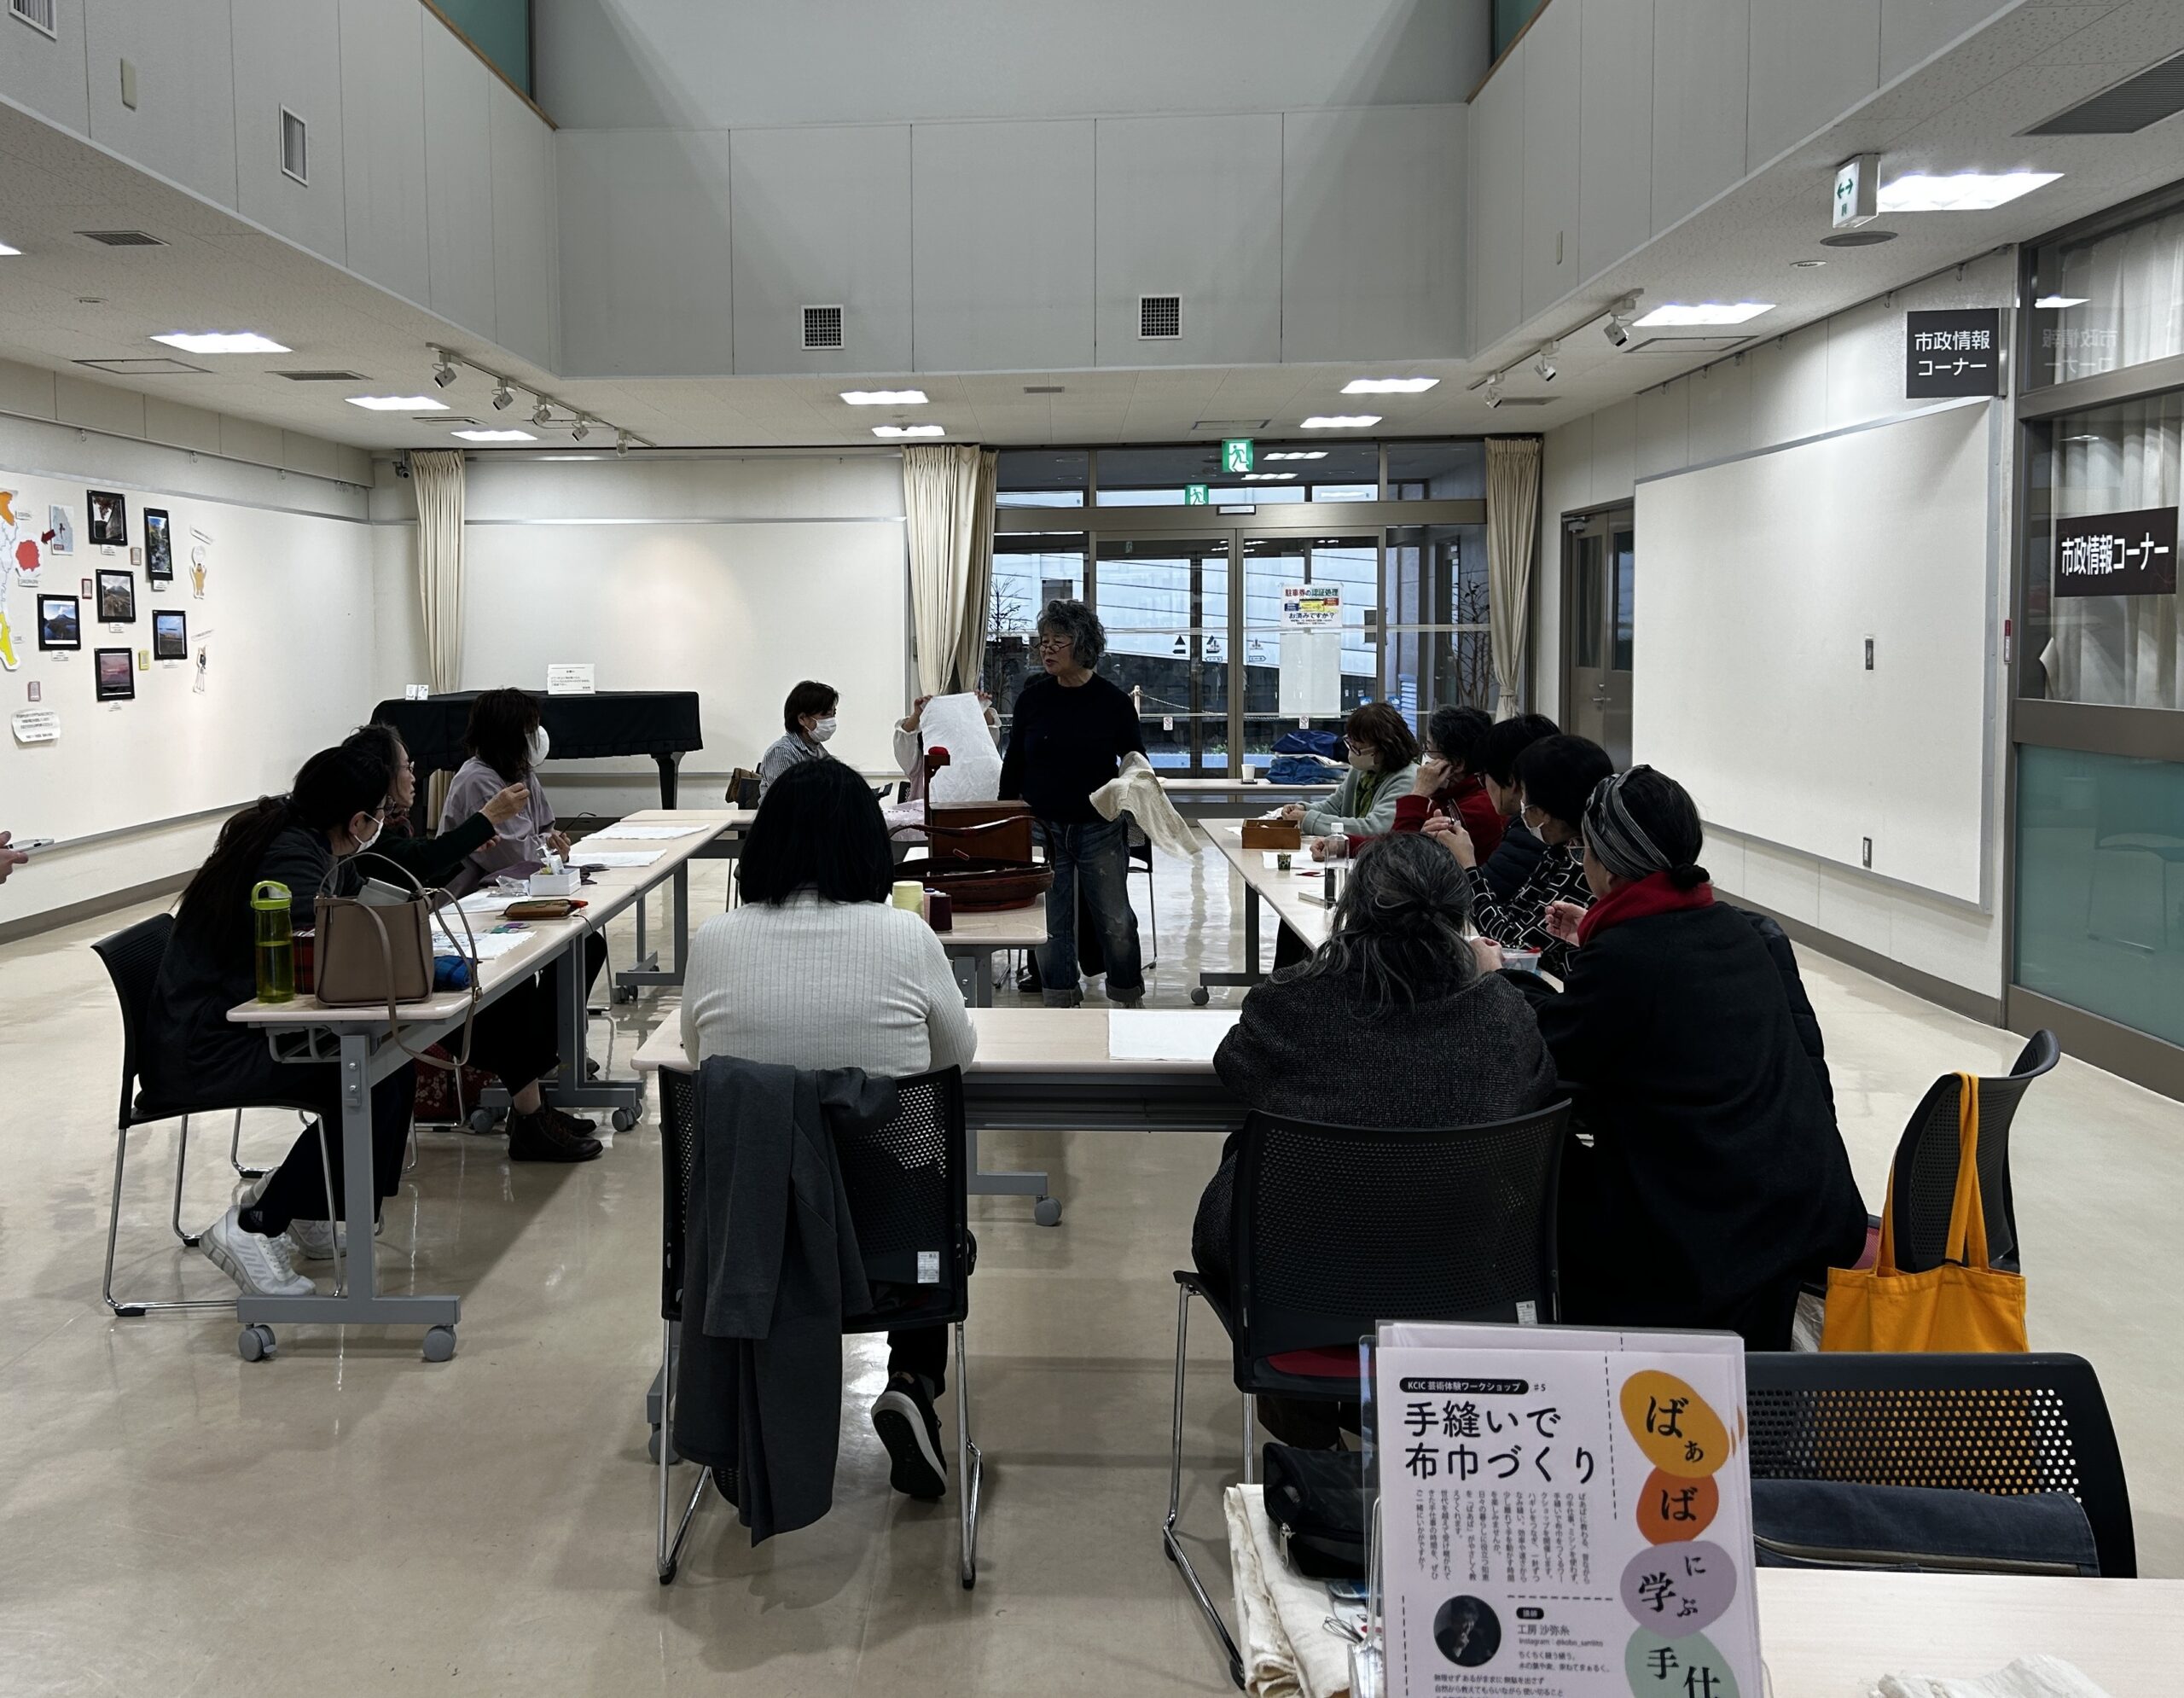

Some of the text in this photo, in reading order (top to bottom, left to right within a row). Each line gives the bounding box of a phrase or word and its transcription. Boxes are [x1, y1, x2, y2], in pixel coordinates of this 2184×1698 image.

[1914, 330, 1990, 352] 市政情報
[1918, 358, 1987, 376] コーナー
[2060, 532, 2170, 576] 市政情報コーナー
[1408, 1381, 1426, 1390] KCIC
[1427, 1381, 1521, 1393] 芸術体験ワークショップ
[1403, 1400, 1561, 1438] 手縫いで
[1405, 1442, 1594, 1484] 布巾づくり
[1517, 1625, 1537, 1635] 工房
